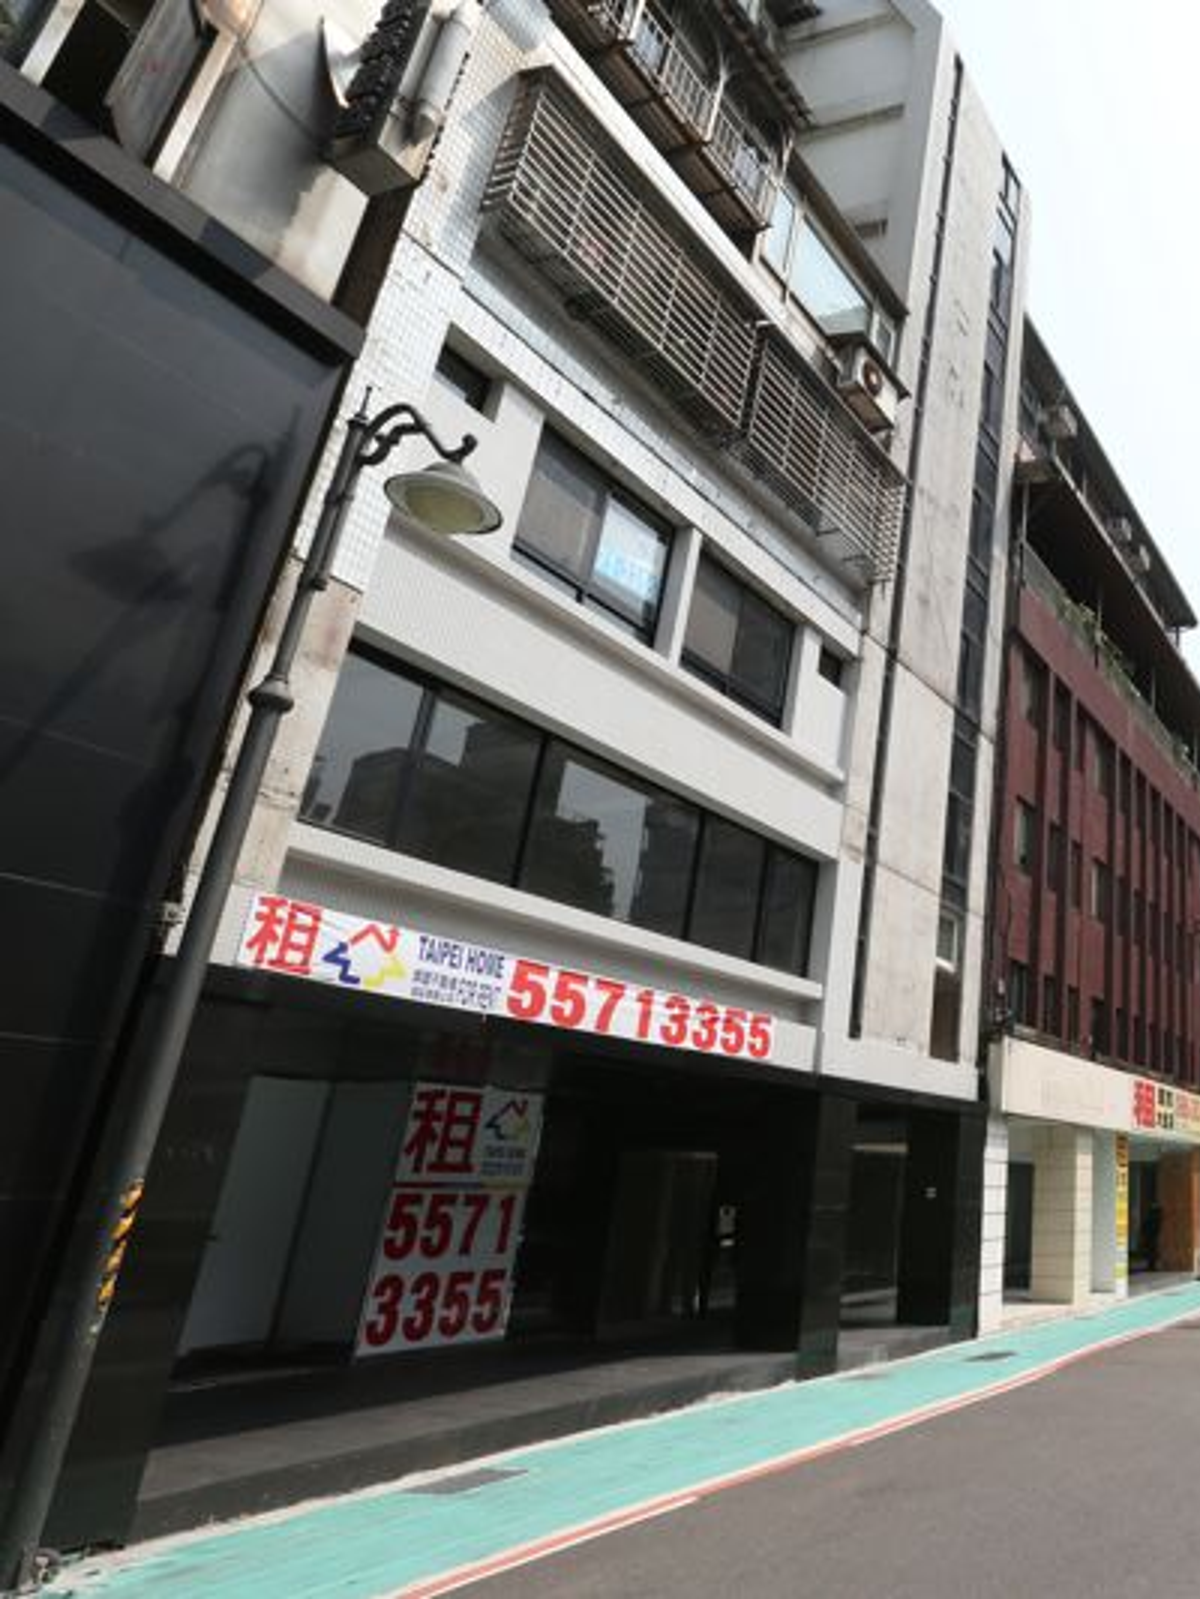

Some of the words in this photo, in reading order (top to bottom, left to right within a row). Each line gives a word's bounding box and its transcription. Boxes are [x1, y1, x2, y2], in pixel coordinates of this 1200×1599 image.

[245, 896, 322, 975] 租
[418, 936, 462, 969] TAIPEI
[466, 947, 505, 979] HOME
[507, 959, 772, 1058] 55713355
[404, 1089, 483, 1173] 租
[384, 1192, 515, 1260] 5571
[365, 1268, 506, 1346] 3355
